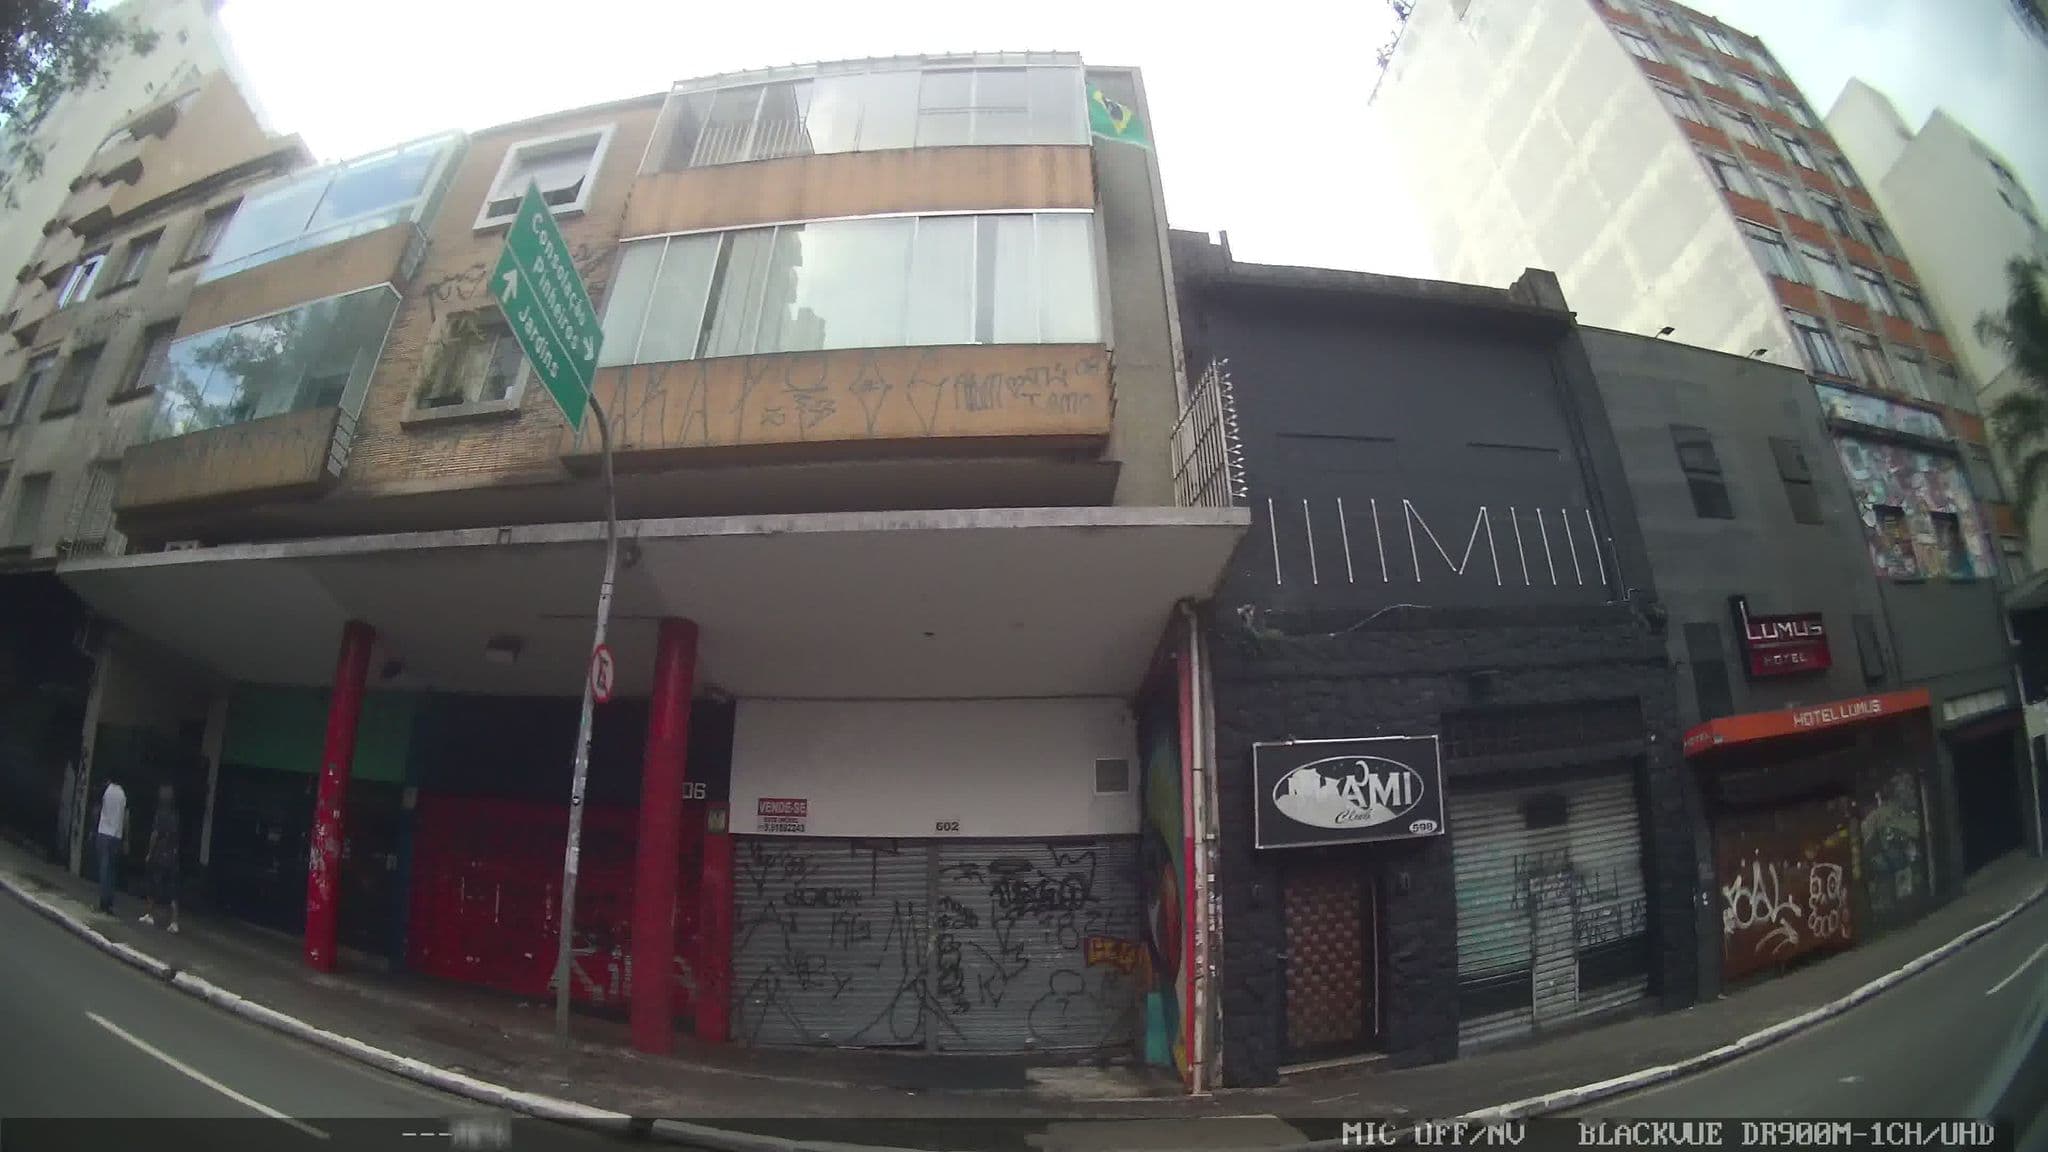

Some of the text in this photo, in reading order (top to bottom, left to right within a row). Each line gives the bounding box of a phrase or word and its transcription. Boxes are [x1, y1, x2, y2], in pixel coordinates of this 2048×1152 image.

[532, 254, 580, 351] Pinheiros
[518, 305, 560, 378] Jardins
[1793, 698, 1882, 728] HOTEL LUMUS
[759, 800, 807, 815] VENDE-SE
[935, 821, 960, 832] 602
[1412, 822, 1434, 832] 598
